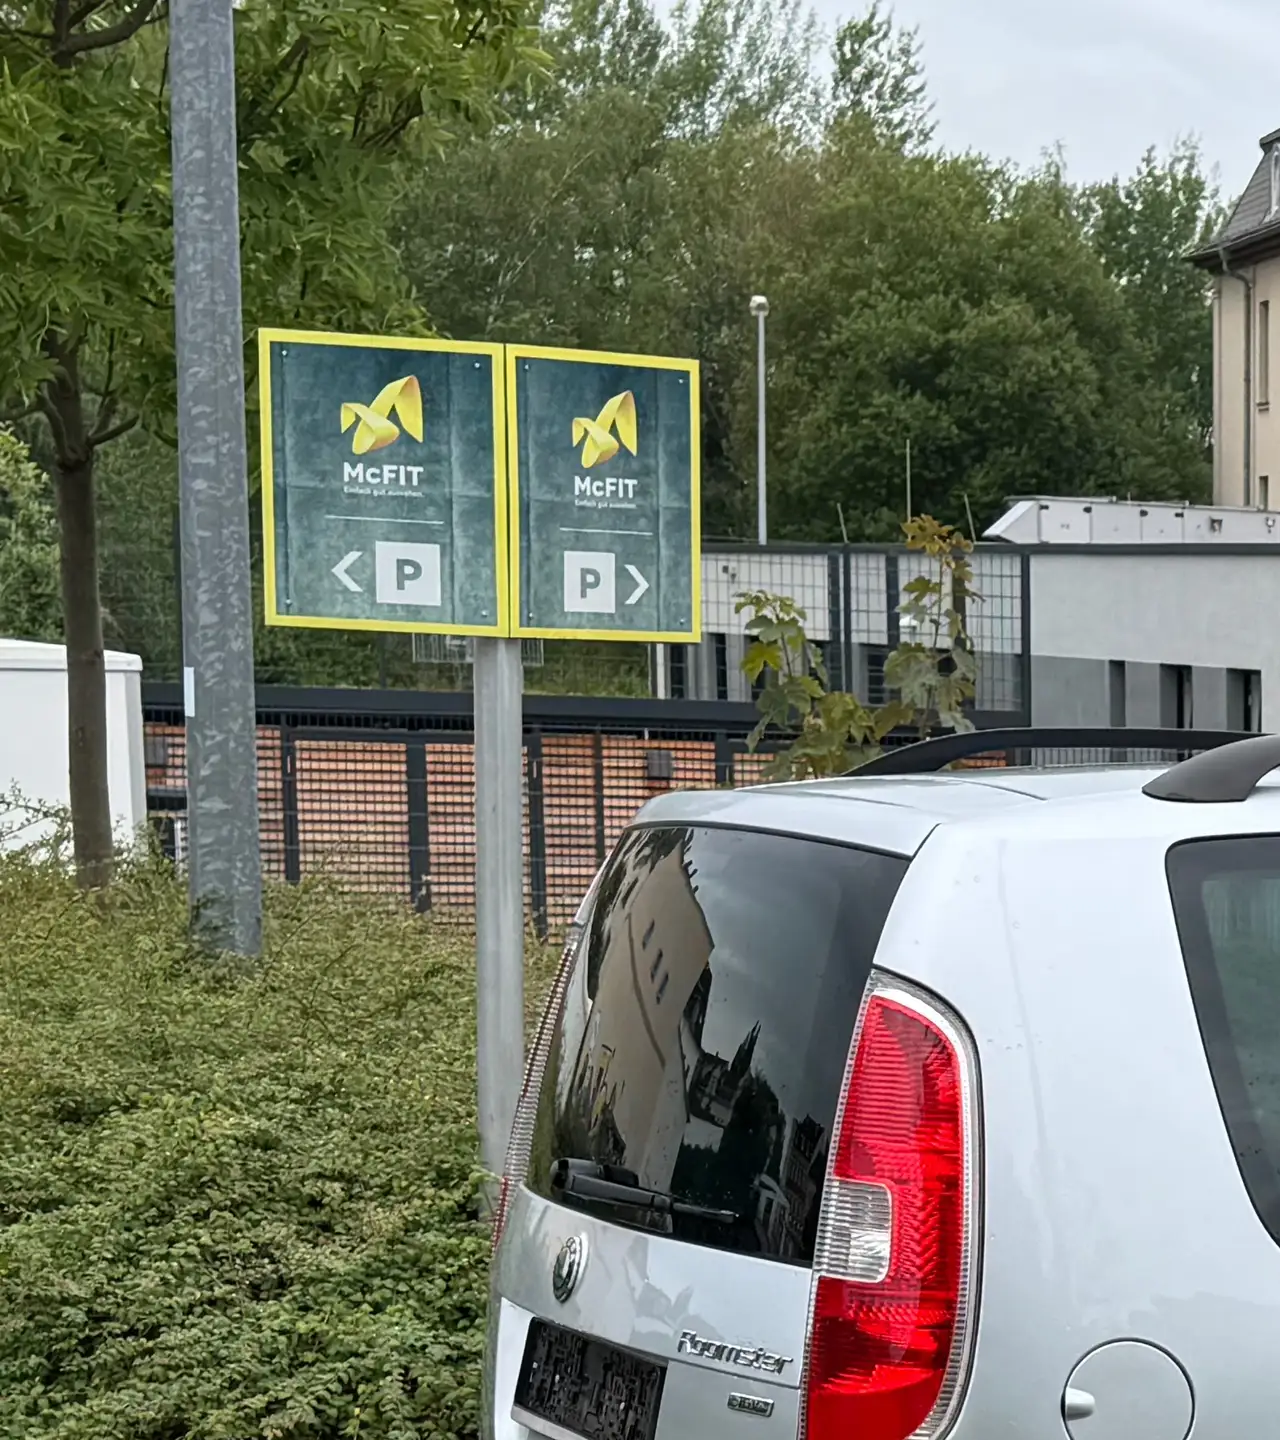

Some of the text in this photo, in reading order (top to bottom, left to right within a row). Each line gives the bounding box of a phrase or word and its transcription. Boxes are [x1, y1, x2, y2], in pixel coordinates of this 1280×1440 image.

[343, 461, 424, 486] McFIT
[574, 475, 638, 498] McFIT
[396, 558, 422, 590] P
[580, 567, 601, 599] P
[677, 1329, 793, 1375] Roomster
